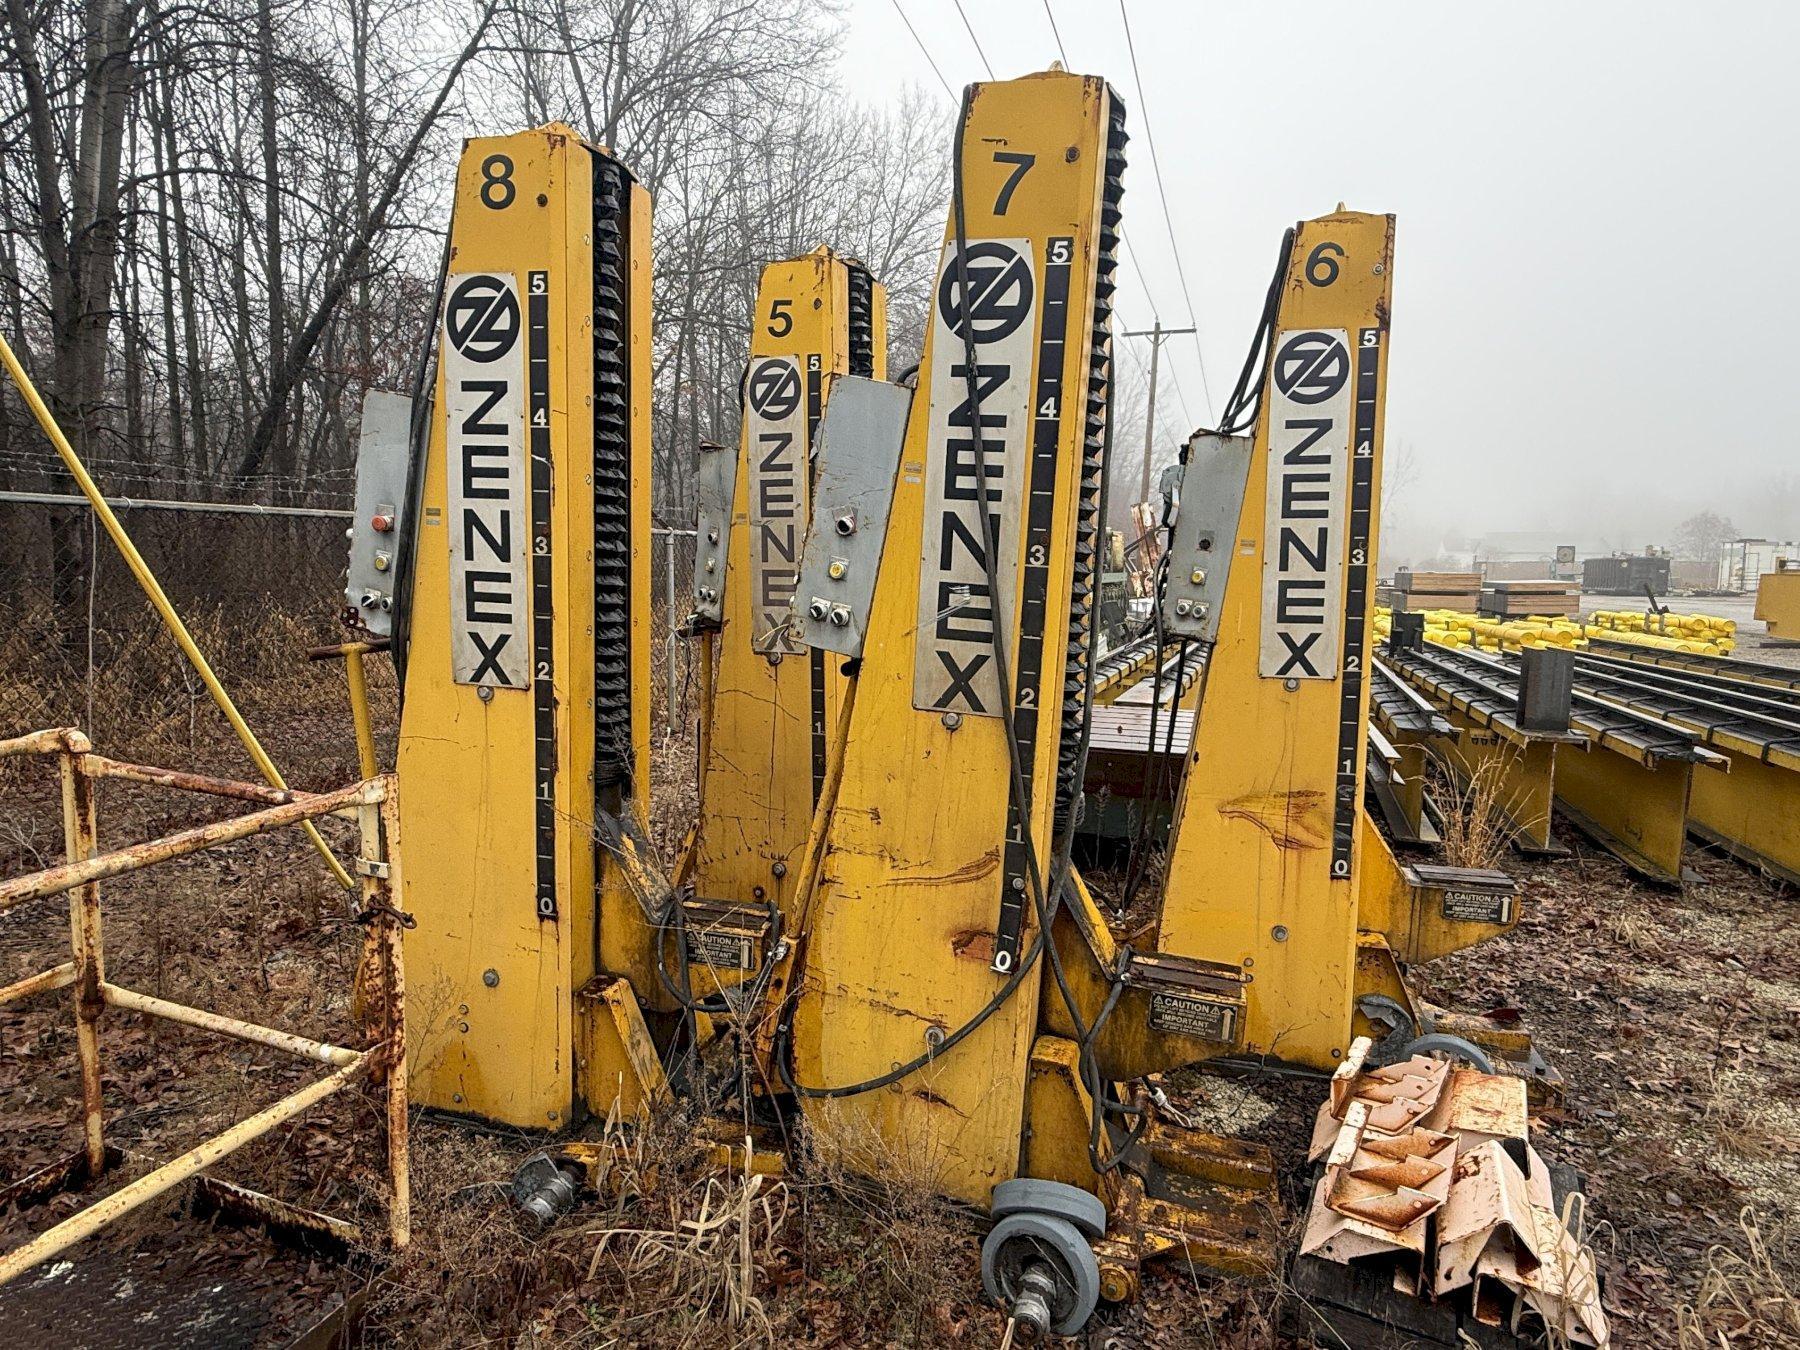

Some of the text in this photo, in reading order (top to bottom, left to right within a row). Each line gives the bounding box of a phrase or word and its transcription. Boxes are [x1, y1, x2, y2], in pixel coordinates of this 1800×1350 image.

[480, 154, 516, 210] 8
[992, 151, 1036, 216] 7
[1051, 240, 1069, 263] 5
[1305, 242, 1345, 288] 6
[531, 274, 546, 294] 5
[767, 299, 793, 338] 5
[1363, 330, 1377, 346] 5
[809, 355, 820, 370] 5
[533, 407, 547, 426] 4
[1040, 397, 1057, 419] 4
[1357, 440, 1371, 456] 4
[460, 380, 513, 686] ZENEX
[759, 432, 797, 651] ZENEX
[933, 364, 1011, 713] ZENEX
[535, 536, 548, 554] 3
[1275, 418, 1334, 677] ZENEX
[1029, 544, 1046, 565] 3
[1351, 548, 1365, 565] 3
[537, 661, 550, 679] 2
[1347, 655, 1359, 671] 2
[1020, 687, 1035, 708] 2
[814, 721, 822, 734] 1
[1342, 758, 1352, 774] 1
[539, 781, 549, 798] 1
[1012, 823, 1023, 842] 1
[1334, 859, 1348, 874] 0
[540, 896, 553, 914] 0
[1454, 893, 1491, 902] CAUTION
[1452, 905, 1492, 914] IMPORTANT
[694, 947, 732, 959] IMORTANT
[995, 950, 1012, 971] 0
[1164, 997, 1210, 1014] CAUTION
[1161, 1013, 1210, 1029] IMPORTANT
